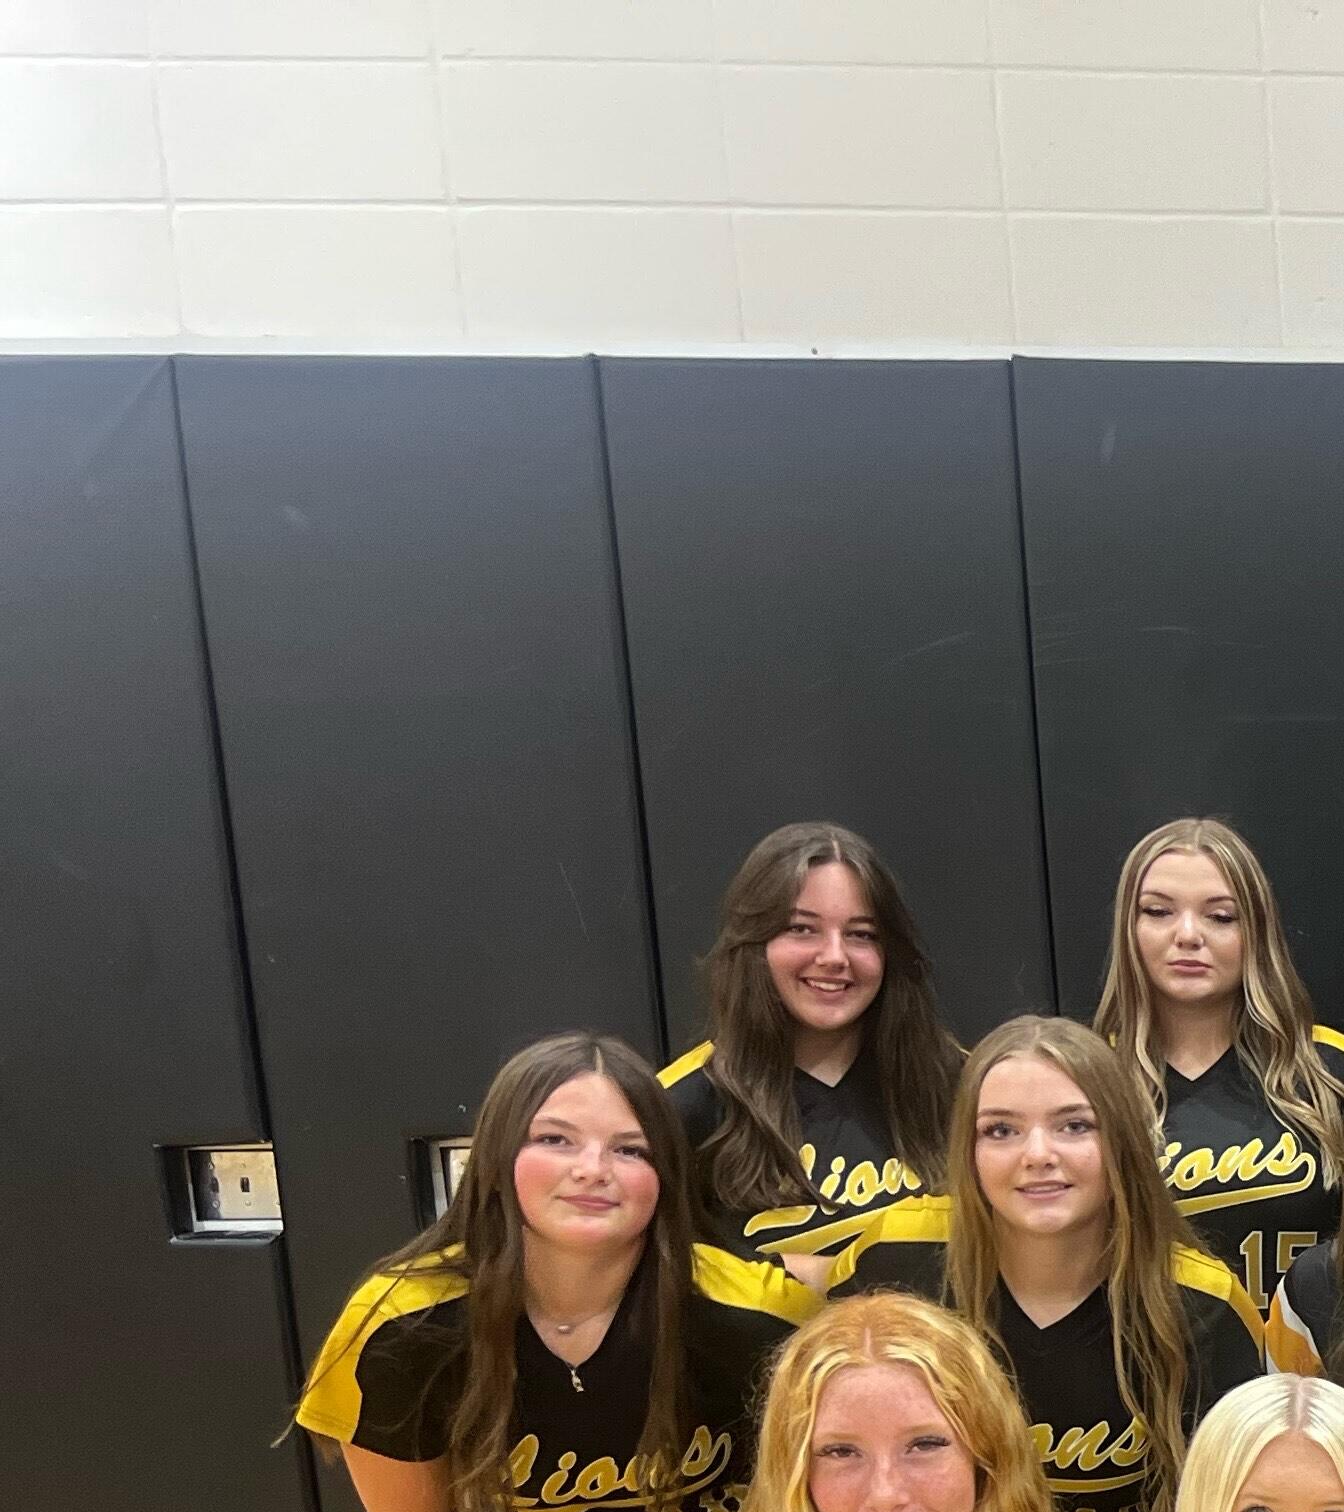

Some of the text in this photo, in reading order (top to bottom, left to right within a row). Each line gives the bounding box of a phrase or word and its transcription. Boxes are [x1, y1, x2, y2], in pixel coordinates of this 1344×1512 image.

[743, 1143, 924, 1237] Lion
[1157, 1131, 1302, 1192] ions
[1027, 1420, 1151, 1472] ons
